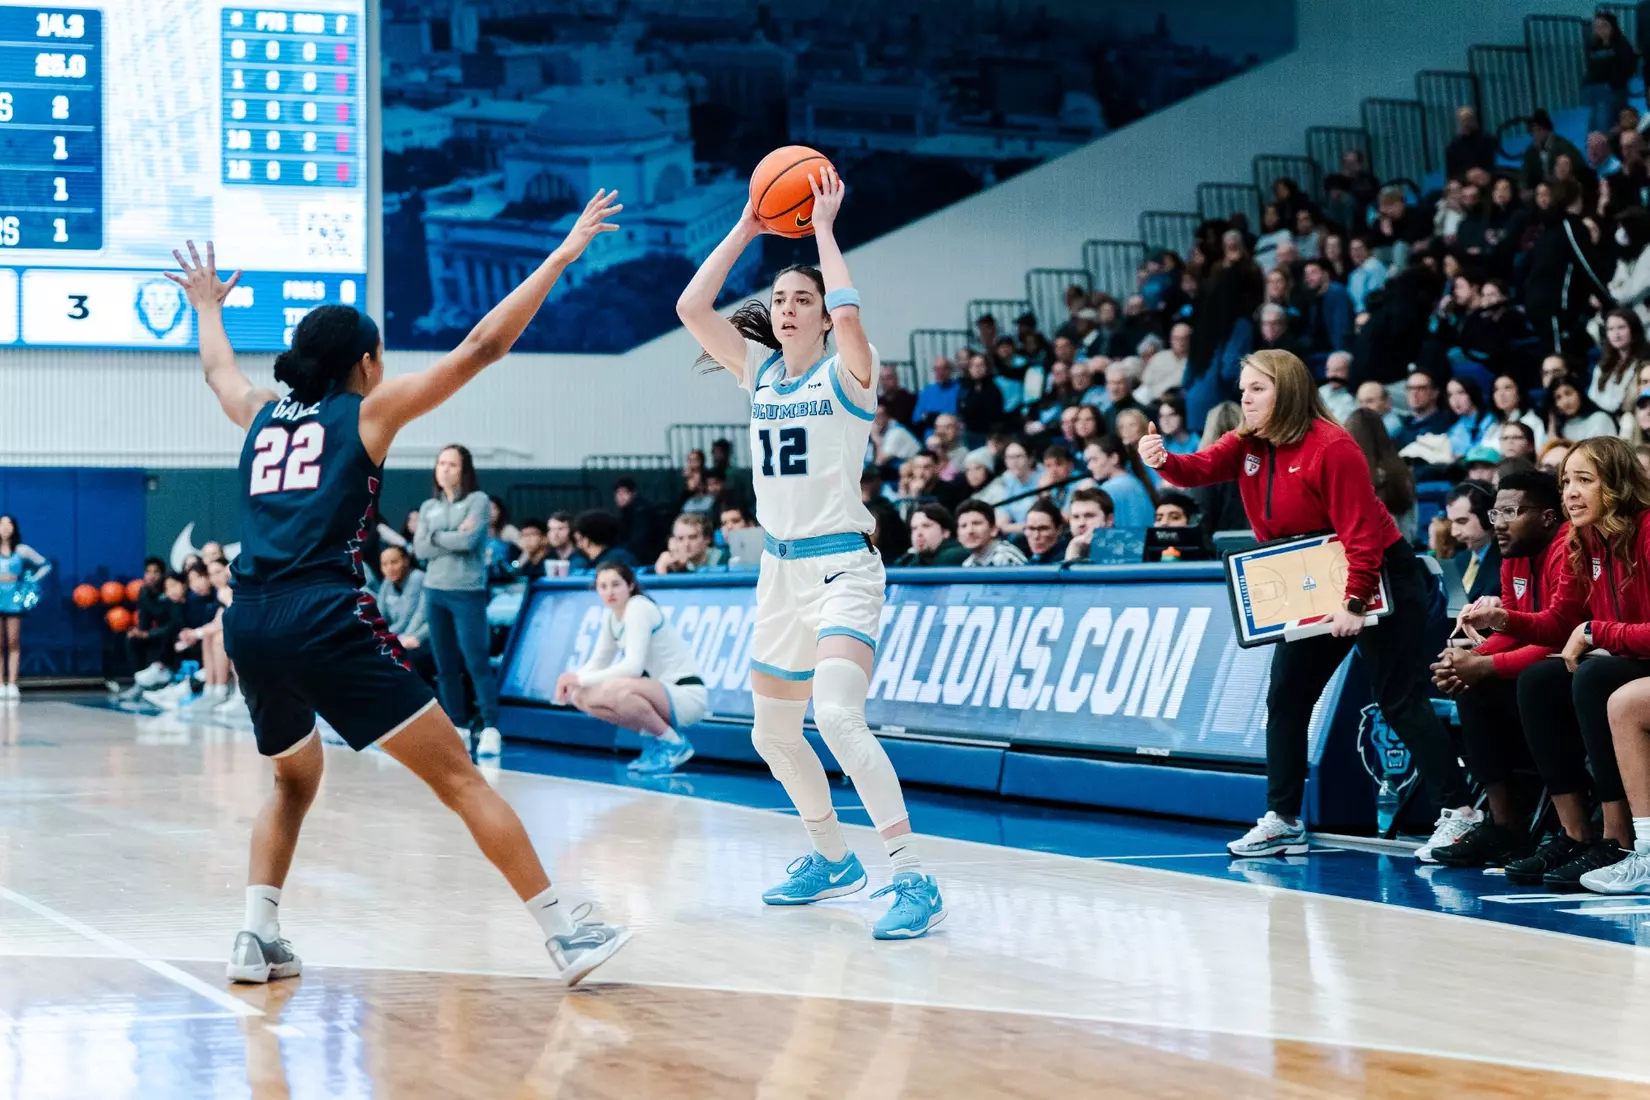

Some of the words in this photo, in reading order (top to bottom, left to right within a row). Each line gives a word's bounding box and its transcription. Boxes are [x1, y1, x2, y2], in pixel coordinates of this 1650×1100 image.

[53, 136, 68, 160] 1
[53, 177, 69, 201] 1
[53, 218, 69, 243] 1
[67, 295, 90, 320] 3
[753, 399, 834, 420] OLUMBIA
[250, 422, 325, 496] 22
[758, 427, 809, 477] 12
